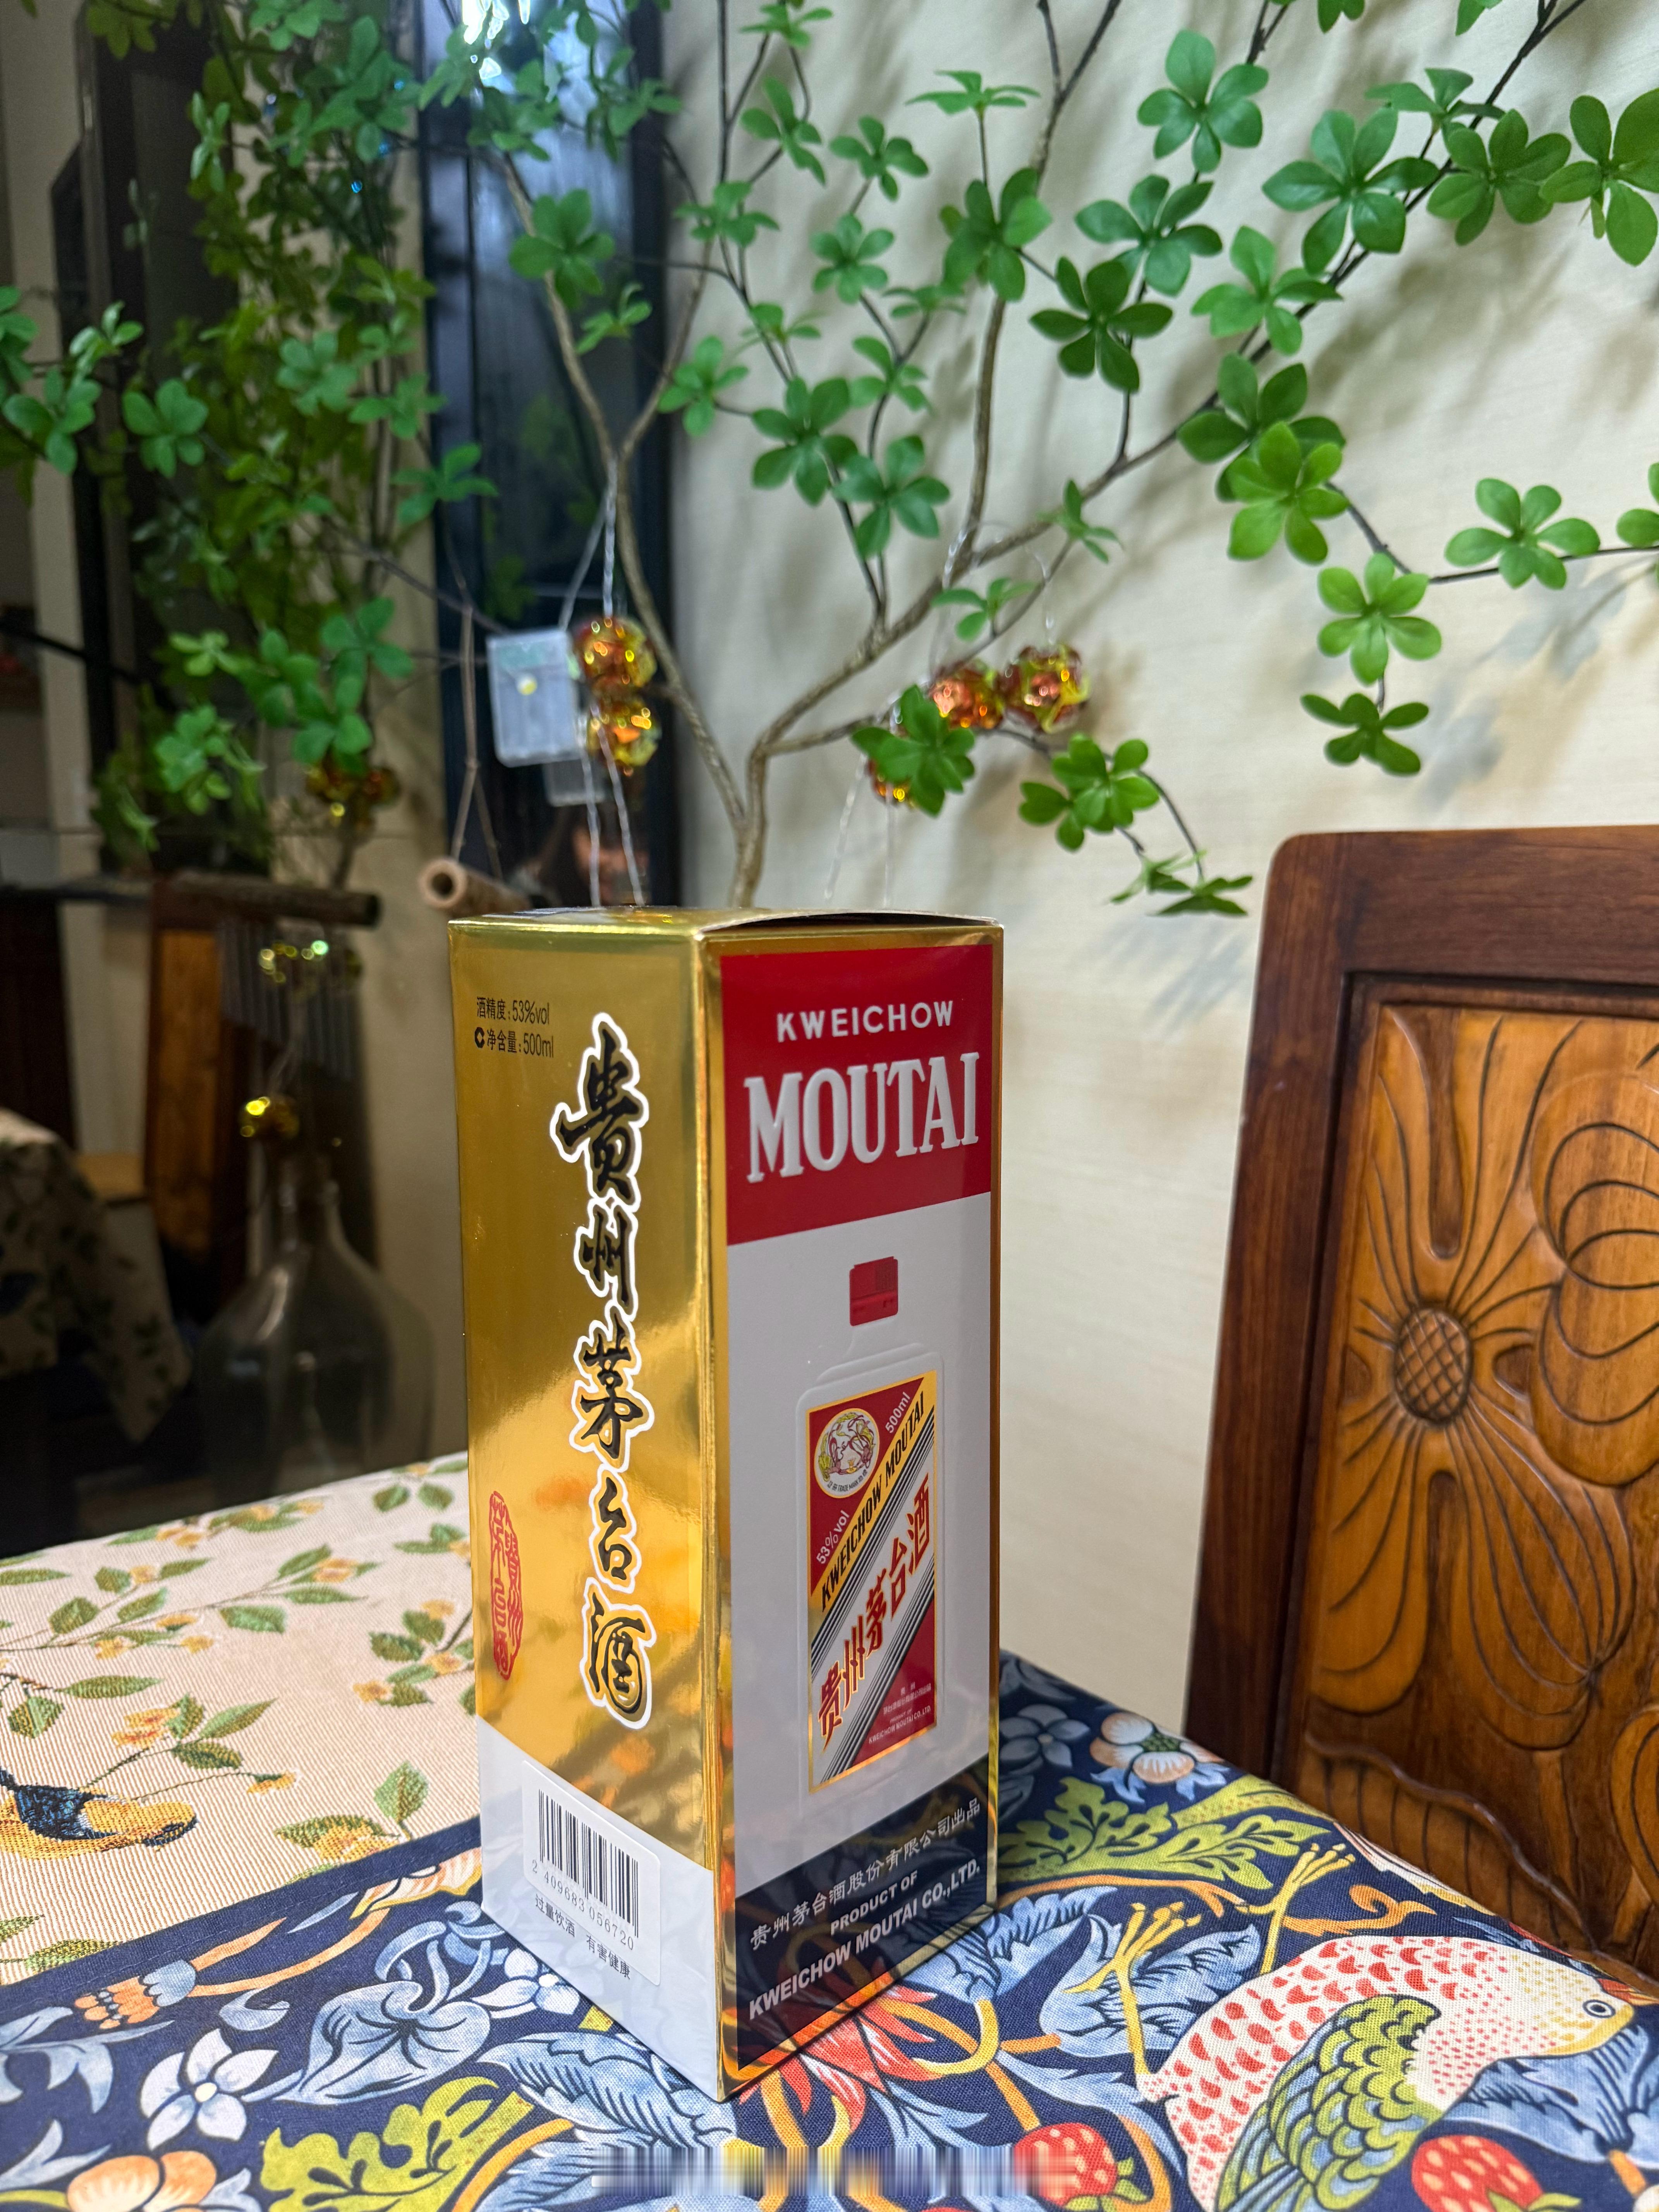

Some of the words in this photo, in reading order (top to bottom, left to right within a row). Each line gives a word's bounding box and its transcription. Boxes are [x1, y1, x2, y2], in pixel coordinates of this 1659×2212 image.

[776, 1001, 953, 1042] KWEICHOW
[744, 1052, 979, 1183] MOUTAI
[885, 1392, 911, 1433] 500ml
[822, 1474, 883, 1612] KWEICHOW
[885, 1391, 923, 1487] MOUTAI
[818, 1473, 930, 1752] 贵州茅台酒
[869, 1725, 895, 1744] KWEICHOW
[896, 1716, 914, 1730] MOUTAI
[532, 1860, 538, 1874] 2
[544, 1873, 585, 1912] 409683
[589, 1907, 634, 1951] 056720
[750, 1797, 981, 1950] 贵州茅台酒股份有限公司出品
[830, 1887, 898, 1936] PRODUCT
[900, 1870, 918, 1892] OF
[535, 1893, 575, 1937] 过量饮酒
[586, 1934, 630, 1980] 有害健康
[749, 1941, 852, 2020] KWEICHOW
[855, 1901, 917, 1955] MOUTAI
